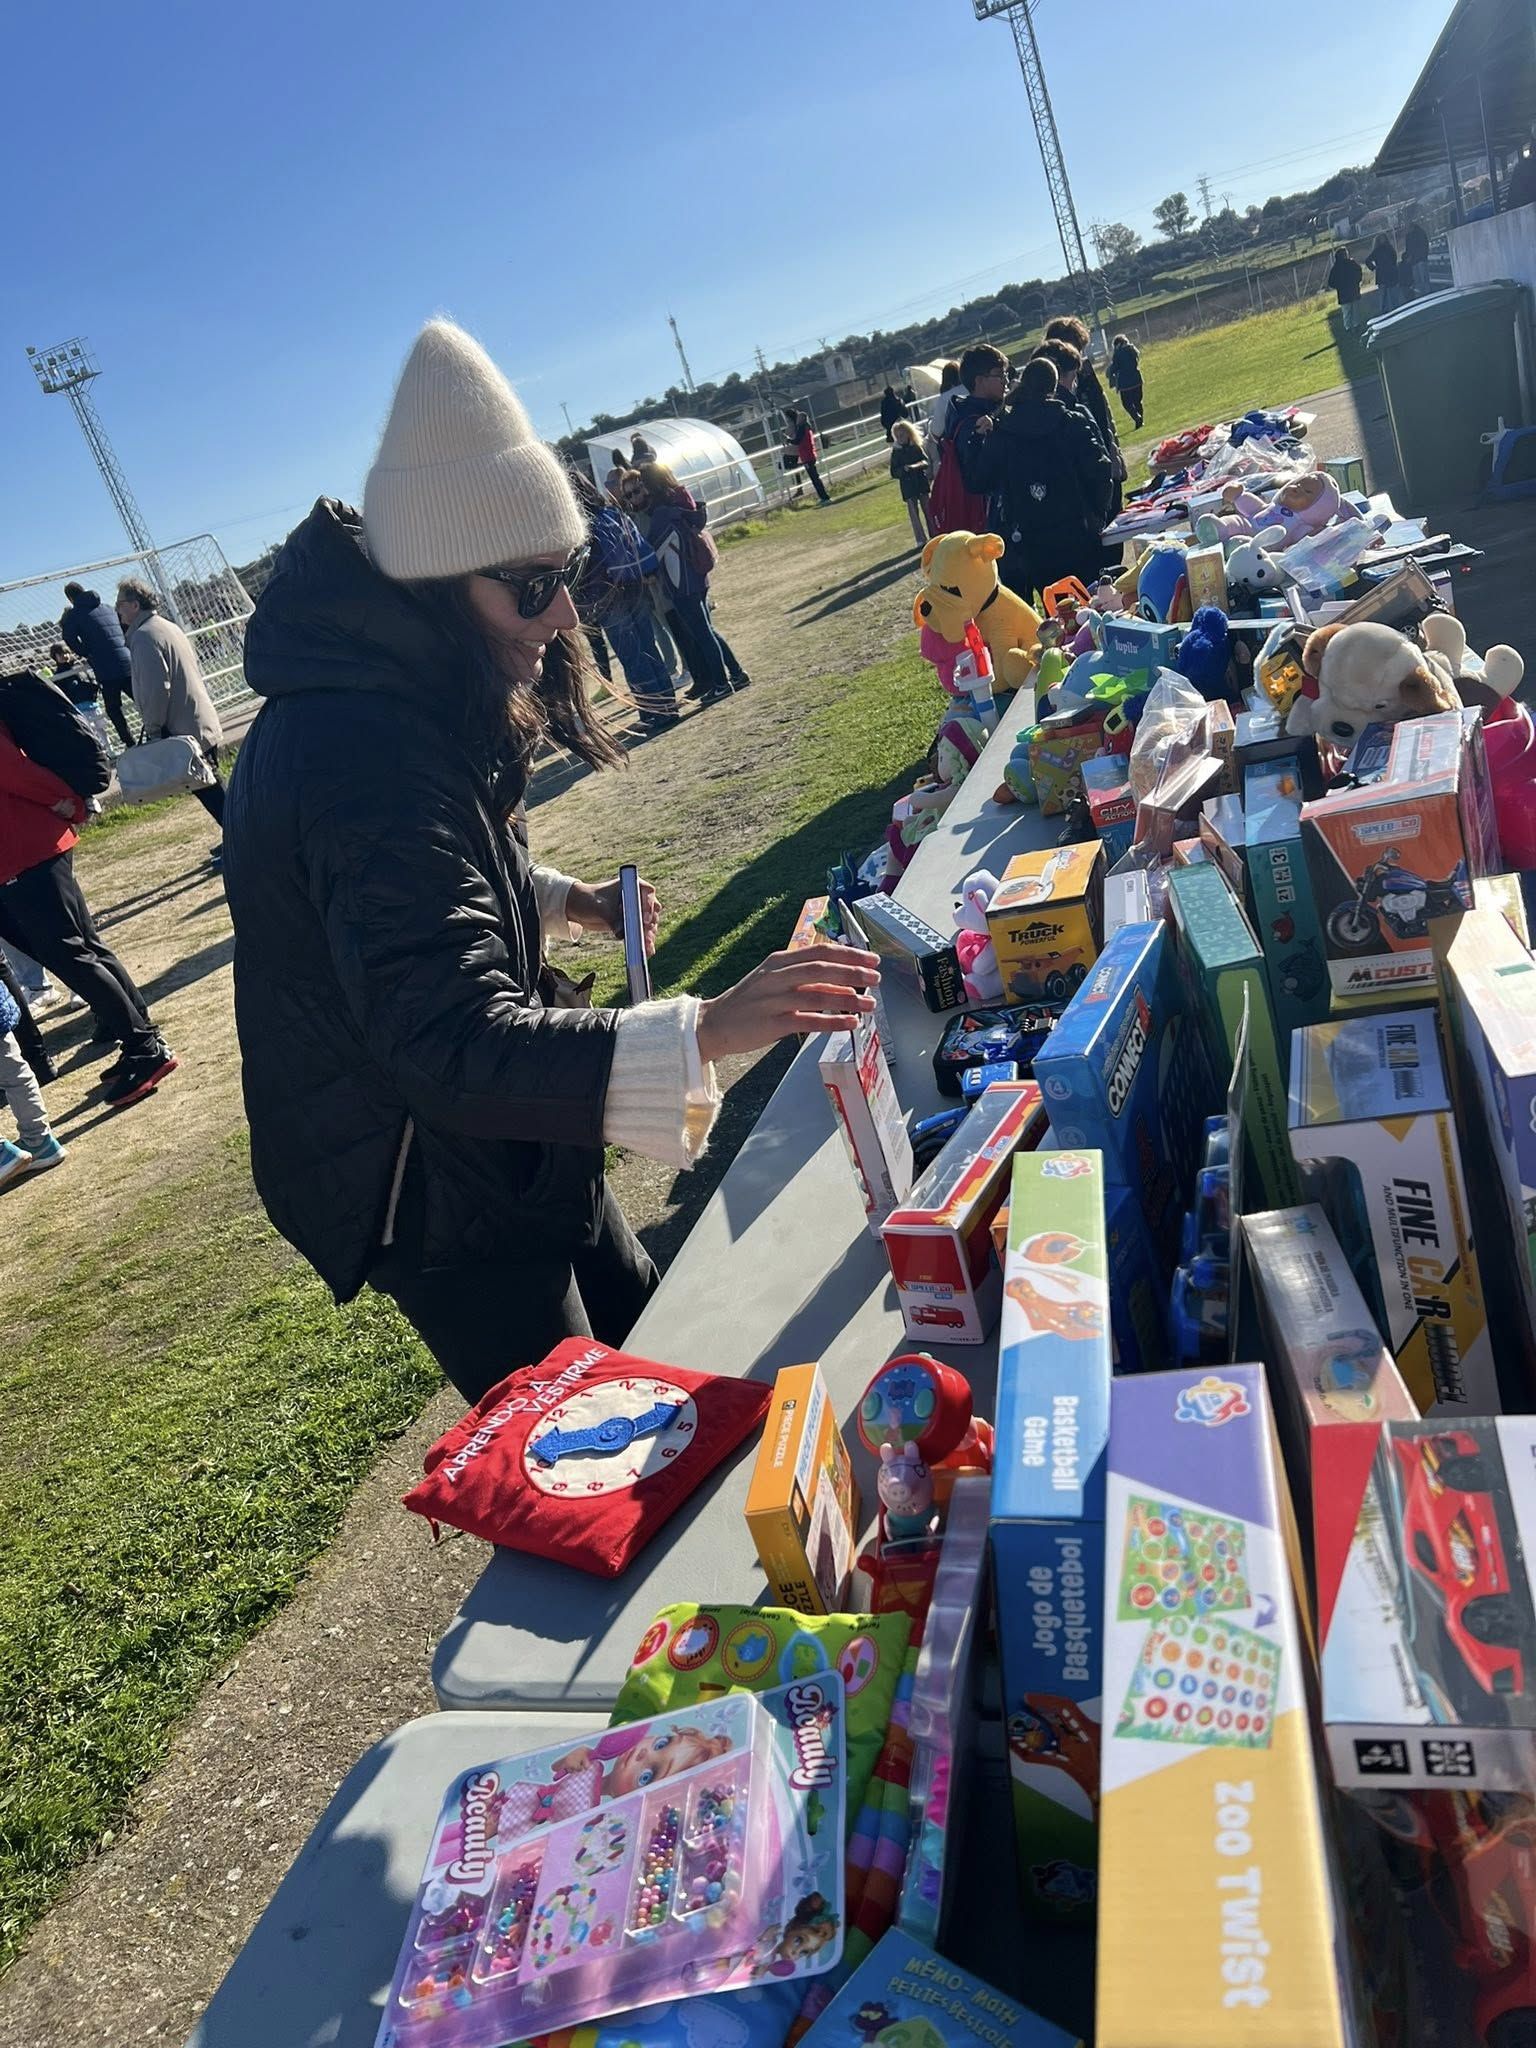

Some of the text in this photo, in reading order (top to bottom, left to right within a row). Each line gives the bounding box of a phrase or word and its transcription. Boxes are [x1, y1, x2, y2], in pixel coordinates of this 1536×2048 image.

[1100, 802, 1130, 817] CITY
[1105, 810, 1136, 821] ACTION
[1008, 923, 1065, 943] TRUCK
[1020, 935, 1056, 946] POWERFUL
[936, 956, 955, 1006] Fashion
[1374, 963, 1433, 980] CUST
[1385, 1024, 1416, 1046] FINE
[1108, 1017, 1147, 1114] CONNECT
[1392, 1177, 1440, 1249] FINE
[1382, 1185, 1413, 1311] AND MULTIFUNCTION IN ONE
[1407, 1255, 1451, 1320] CAR
[522, 1347, 608, 1414] VESTIRME
[580, 1392, 593, 1400] 1
[619, 1380, 637, 1391] 2
[653, 1385, 669, 1396] 3
[443, 1380, 553, 1482] APRENDO A
[544, 1408, 568, 1424] 12
[677, 1421, 694, 1432] 5
[661, 1447, 678, 1458] 6
[773, 1434, 790, 1468] PUZZLE
[1024, 1416, 1046, 1467] Game
[1052, 1395, 1081, 1491] Basketball
[552, 1481, 568, 1492] 9
[587, 1481, 604, 1492] 8
[626, 1468, 641, 1479] 7
[796, 1580, 815, 1614] ZZLE
[1027, 1565, 1056, 1657] Jogo de
[1055, 1537, 1089, 1681] Basquetebol
[789, 1684, 839, 1790] Beauty
[444, 1770, 498, 1885] Beauty
[904, 1957, 964, 1991] MÉMO
[948, 2000, 1016, 2048] BESTIOLE
